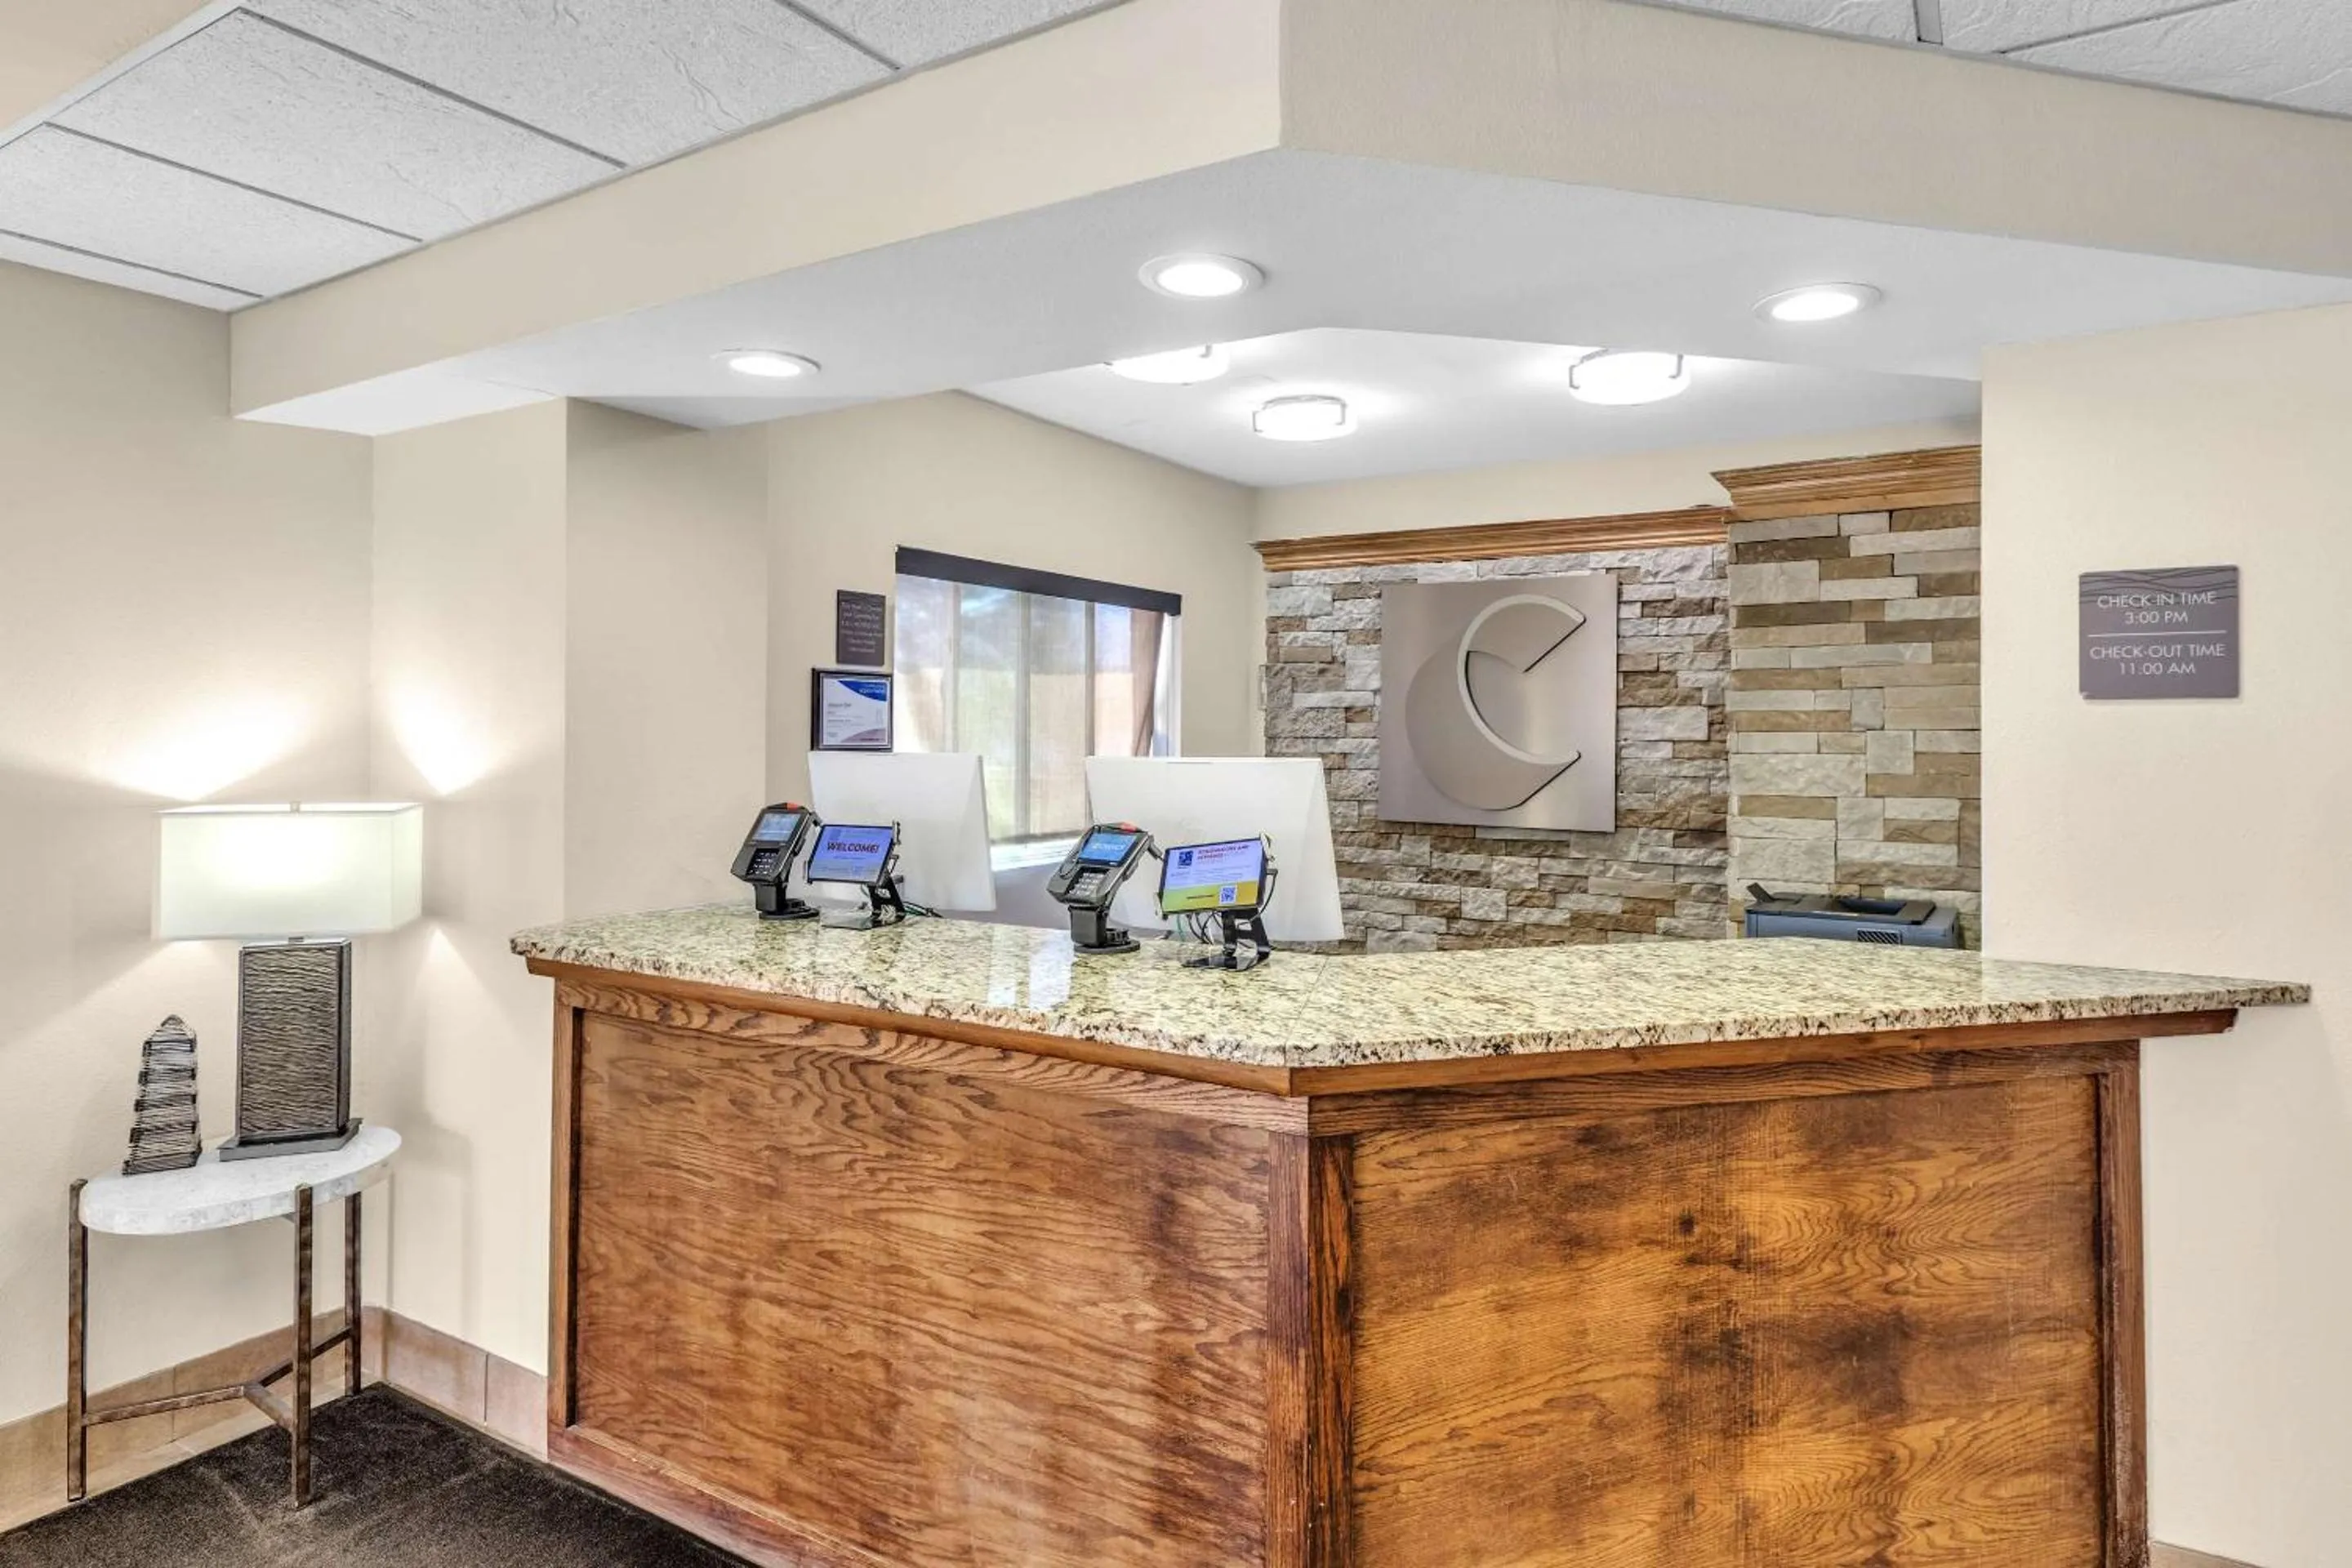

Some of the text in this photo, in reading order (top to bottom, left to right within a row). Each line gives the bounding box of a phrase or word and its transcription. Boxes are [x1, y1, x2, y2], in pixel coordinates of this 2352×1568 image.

[2097, 591, 2217, 608] CHECK-IN TIME
[2124, 611, 2189, 625] 3:00 PM
[2089, 643, 2226, 660] CHECK-OUT TIME
[2167, 662, 2196, 675] AM
